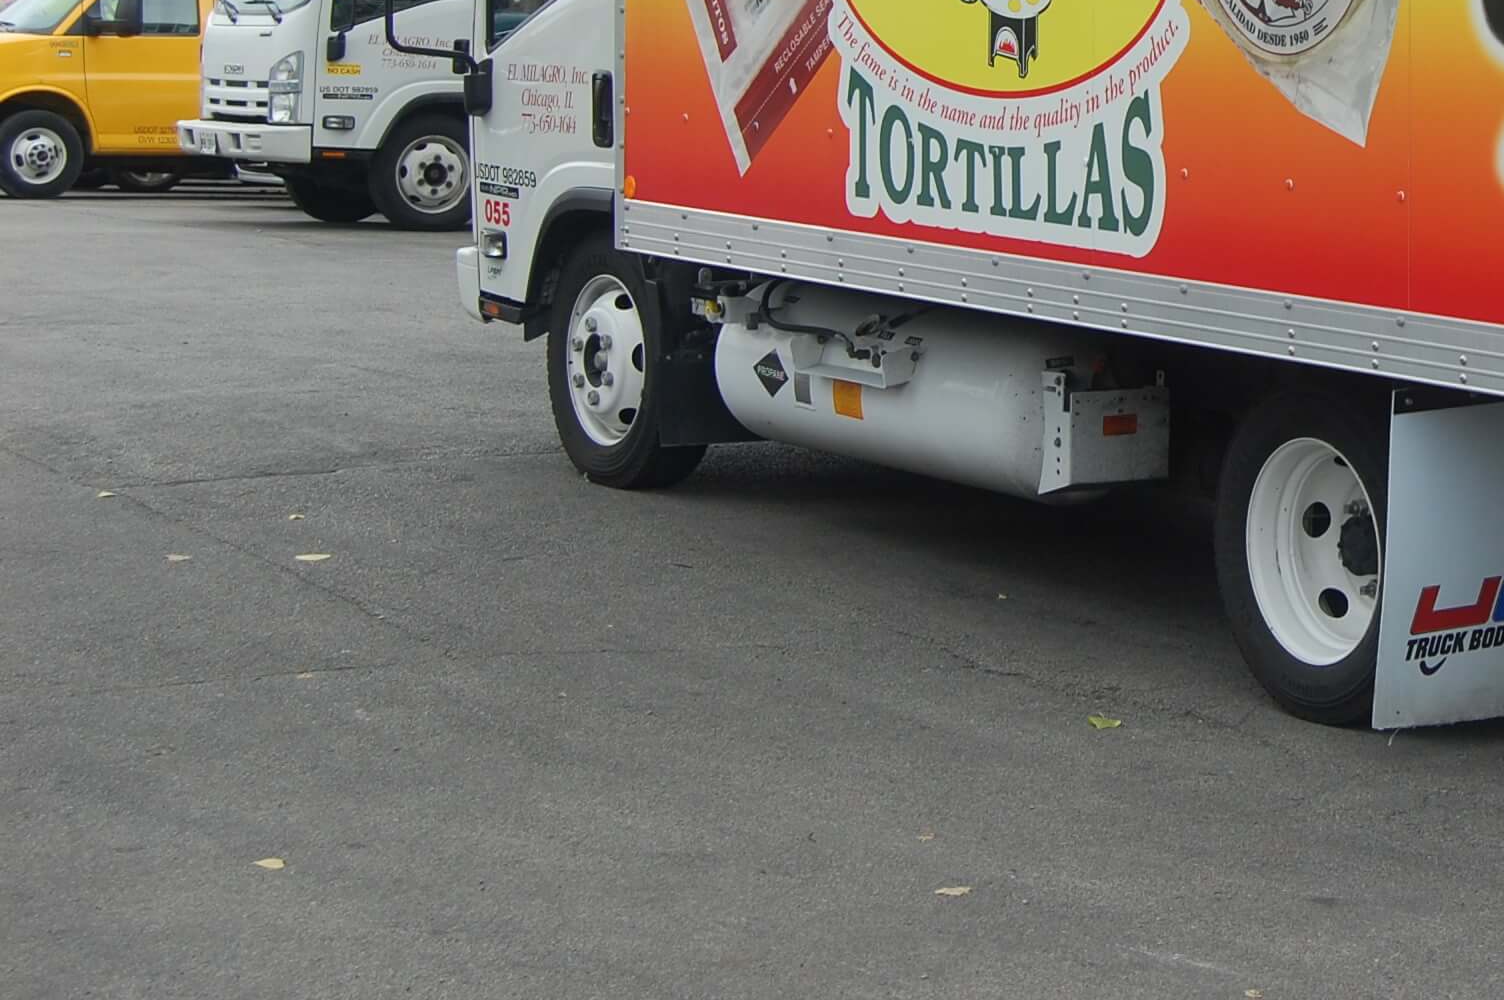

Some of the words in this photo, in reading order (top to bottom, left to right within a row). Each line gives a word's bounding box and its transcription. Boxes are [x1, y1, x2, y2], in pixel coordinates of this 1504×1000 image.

[774, 16, 817, 73] RECLOSABLE
[1257, 31, 1288, 48] DESDE
[1289, 30, 1310, 48] 1950
[507, 63, 518, 81] EL
[571, 65, 589, 85] Inc.
[835, 10, 859, 48] The
[853, 42, 887, 81] fame
[888, 68, 899, 90] is
[900, 77, 915, 99] in
[918, 87, 938, 115] the
[940, 103, 977, 127] name
[979, 105, 1007, 132] and
[1010, 105, 1030, 132] the
[1033, 98, 1083, 138] quality
[1084, 89, 1101, 115] in
[1104, 74, 1126, 107] the
[1128, 23, 1179, 92] product.
[521, 88, 560, 112] Chicago,
[521, 113, 577, 135] 773-650-1614
[847, 65, 1156, 238] TORTILLAS
[502, 167, 537, 189] 982859
[484, 199, 512, 228] 055
[1405, 631, 1468, 662] TRUCK
